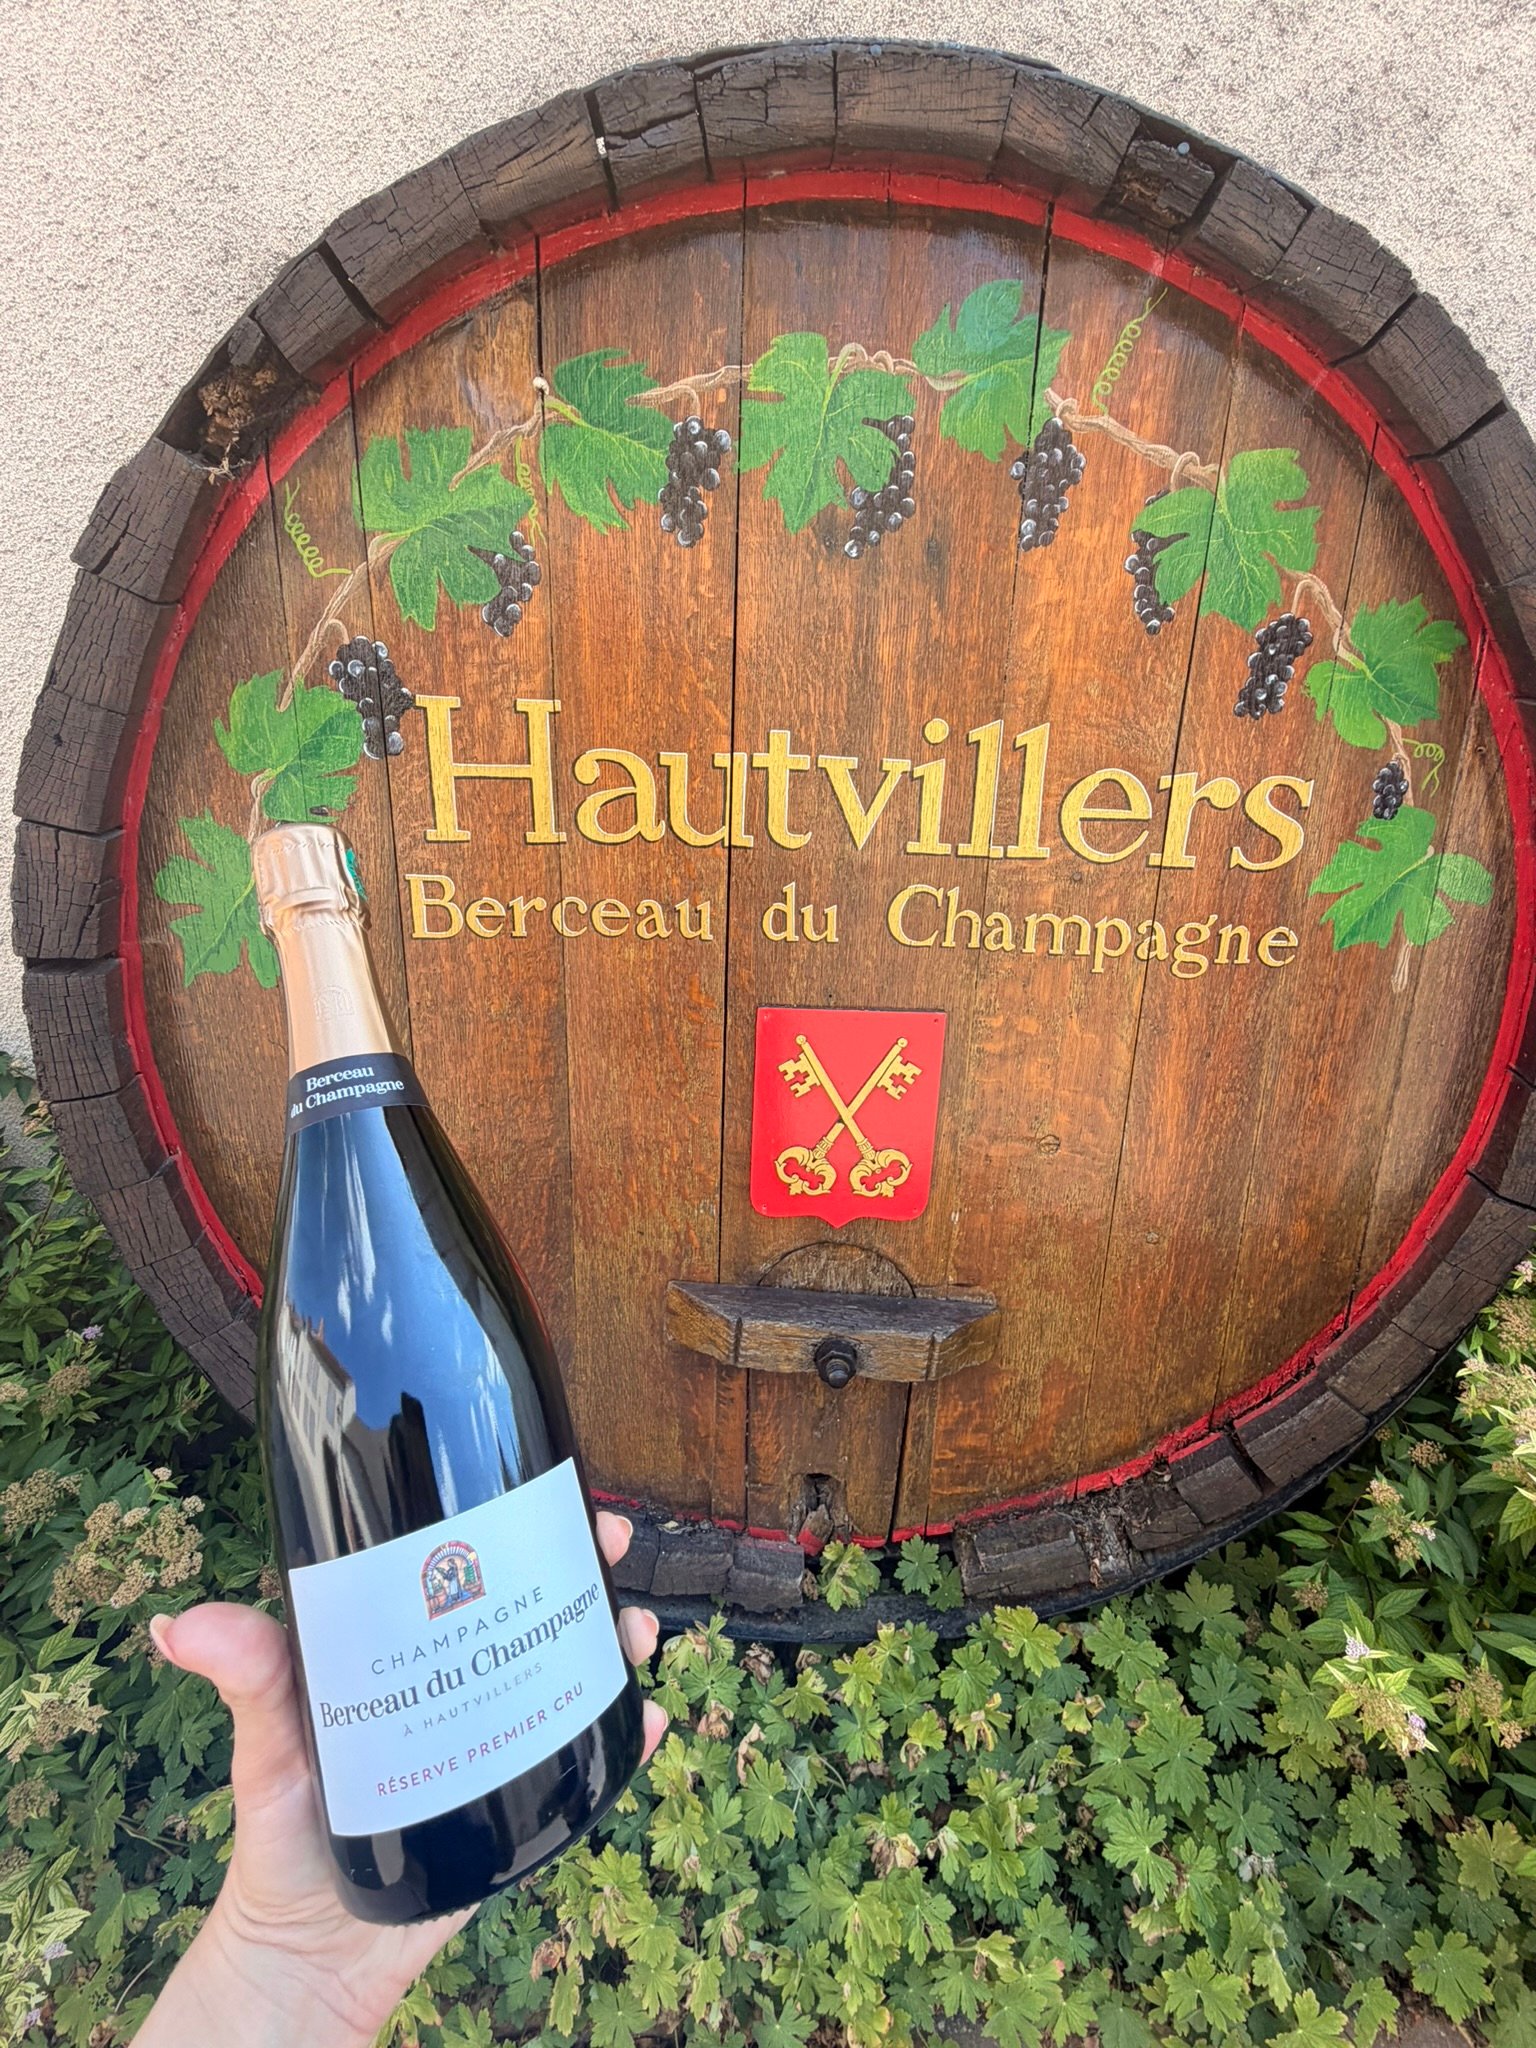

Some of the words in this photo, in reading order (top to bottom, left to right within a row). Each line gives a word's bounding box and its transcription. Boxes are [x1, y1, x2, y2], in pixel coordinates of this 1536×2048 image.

[414, 694, 1316, 874] Hautvillers
[405, 872, 714, 943] Berceau
[762, 881, 839, 945] du
[887, 884, 1300, 981] Champagne
[305, 1066, 375, 1092] Berceau
[305, 1080, 405, 1109] Champagne
[319, 1685, 421, 1729] Berceau
[426, 1664, 467, 1699] du
[470, 1581, 600, 1678] Champagne
[371, 1586, 544, 1676] CHAMPAGNE
[377, 1756, 461, 1797] RÉSERVE
[467, 1708, 548, 1764] PREMIER
[553, 1681, 584, 1712] CRU
[423, 1662, 543, 1729] HAUTVILLERS
